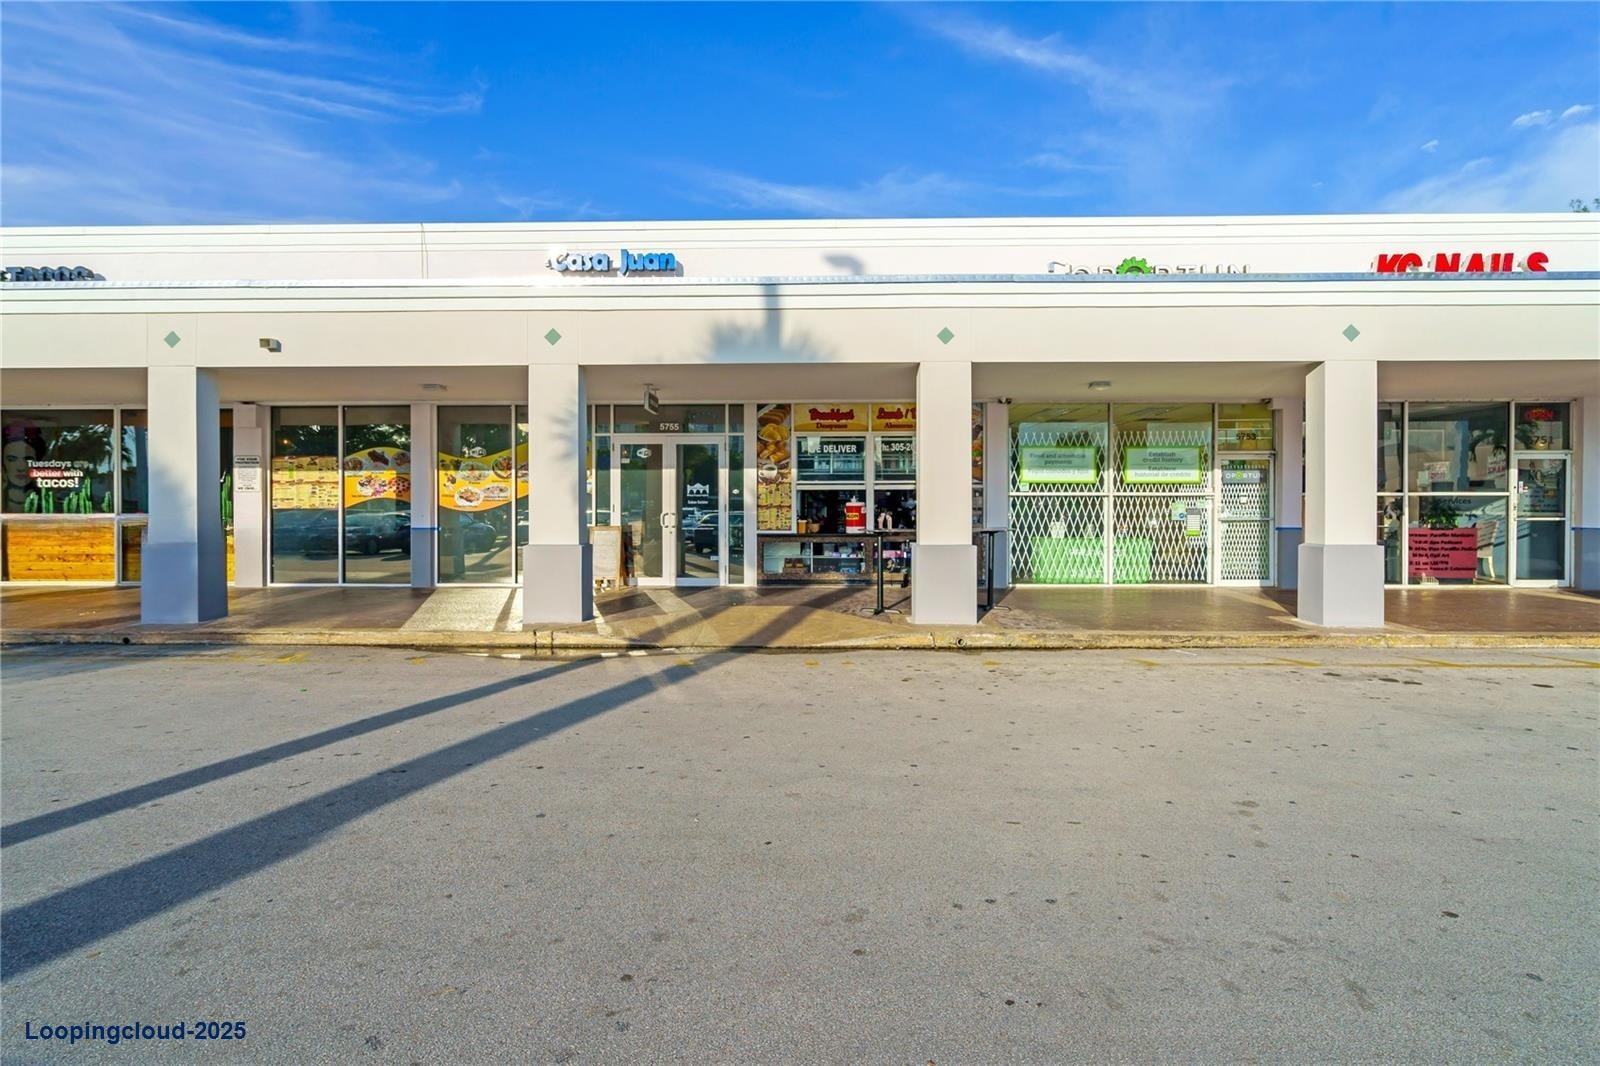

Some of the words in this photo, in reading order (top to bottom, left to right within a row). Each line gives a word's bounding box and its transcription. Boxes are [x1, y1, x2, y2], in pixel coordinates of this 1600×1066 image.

[546, 250, 609, 272] Casa
[620, 249, 675, 276] Juan
[659, 422, 680, 431] 5755
[1236, 432, 1257, 440] 5753
[823, 444, 857, 453] DELIVER
[27, 460, 71, 469] Tuesdays
[63, 469, 83, 477] with
[36, 478, 79, 488] tacos!
